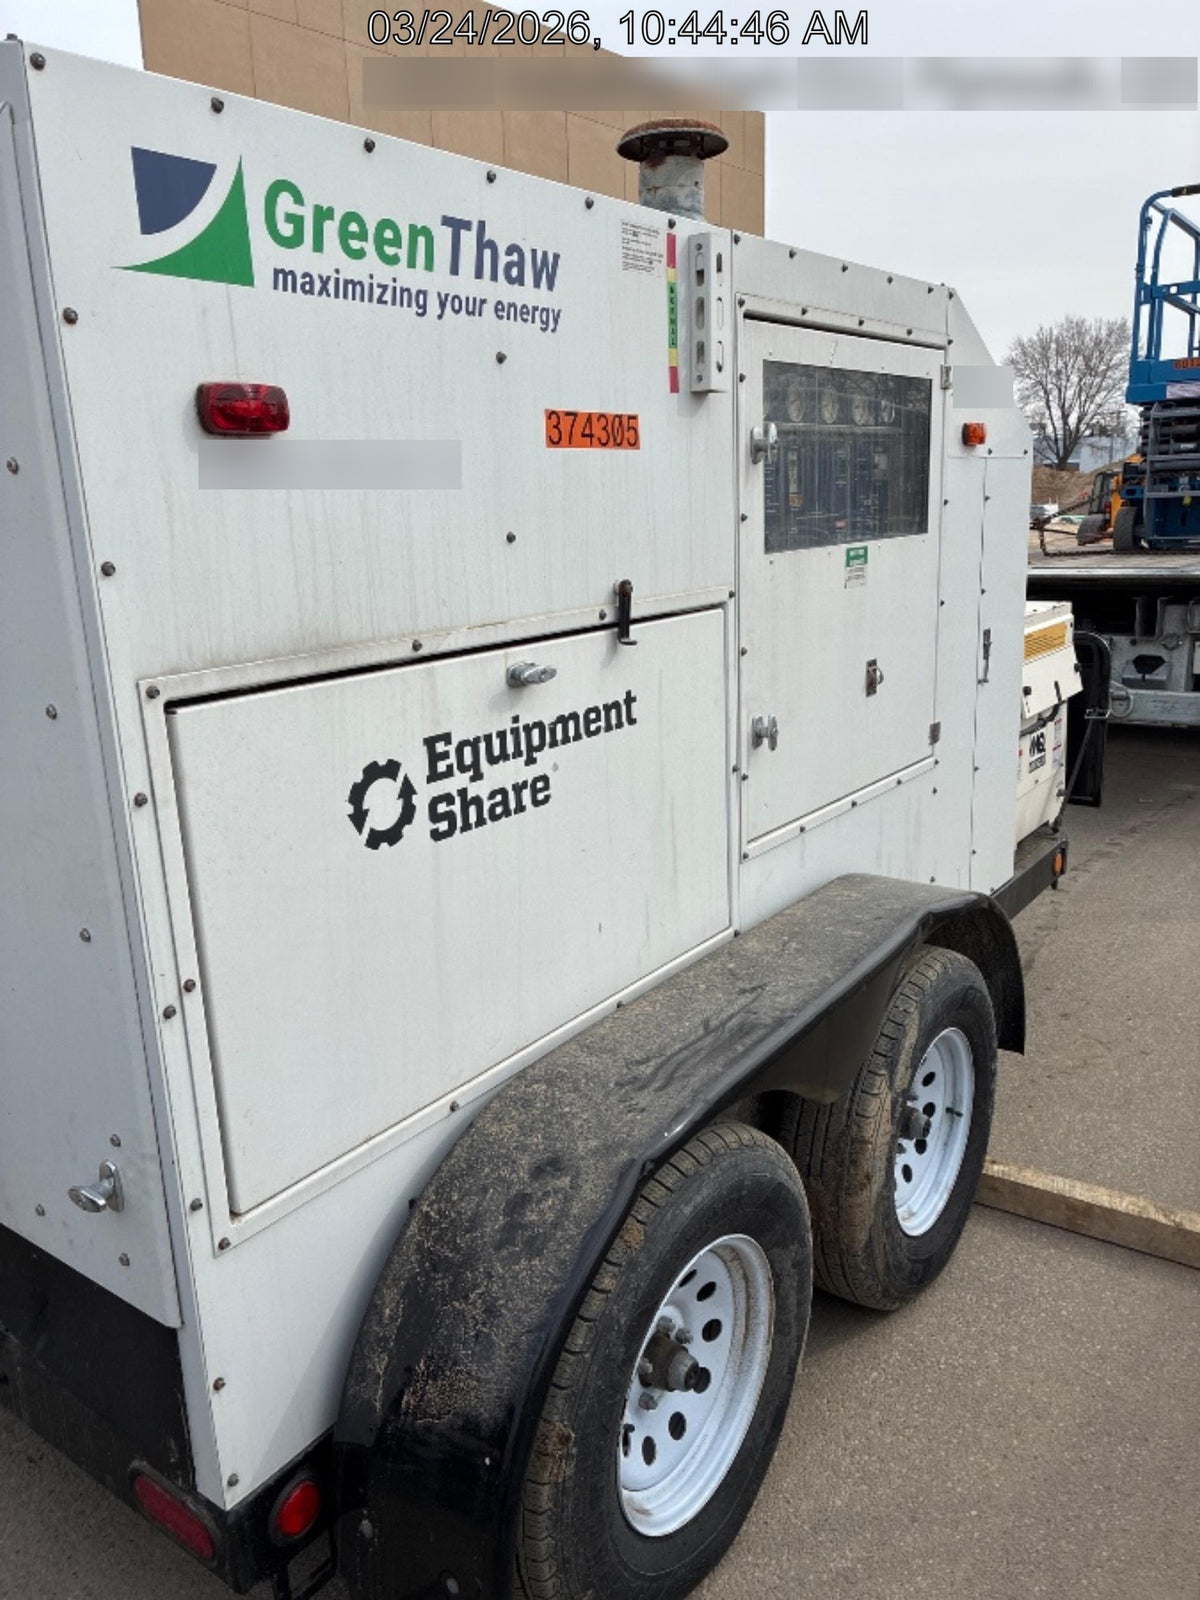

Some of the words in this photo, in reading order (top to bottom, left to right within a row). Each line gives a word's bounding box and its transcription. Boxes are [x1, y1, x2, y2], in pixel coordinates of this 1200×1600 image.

[264, 179, 560, 291] GreenThaw
[272, 267, 428, 317] maximizing
[436, 291, 487, 319] your
[494, 301, 562, 333] energy
[548, 410, 639, 446] 374305
[423, 689, 637, 784] Equipment
[429, 772, 551, 842] Share
